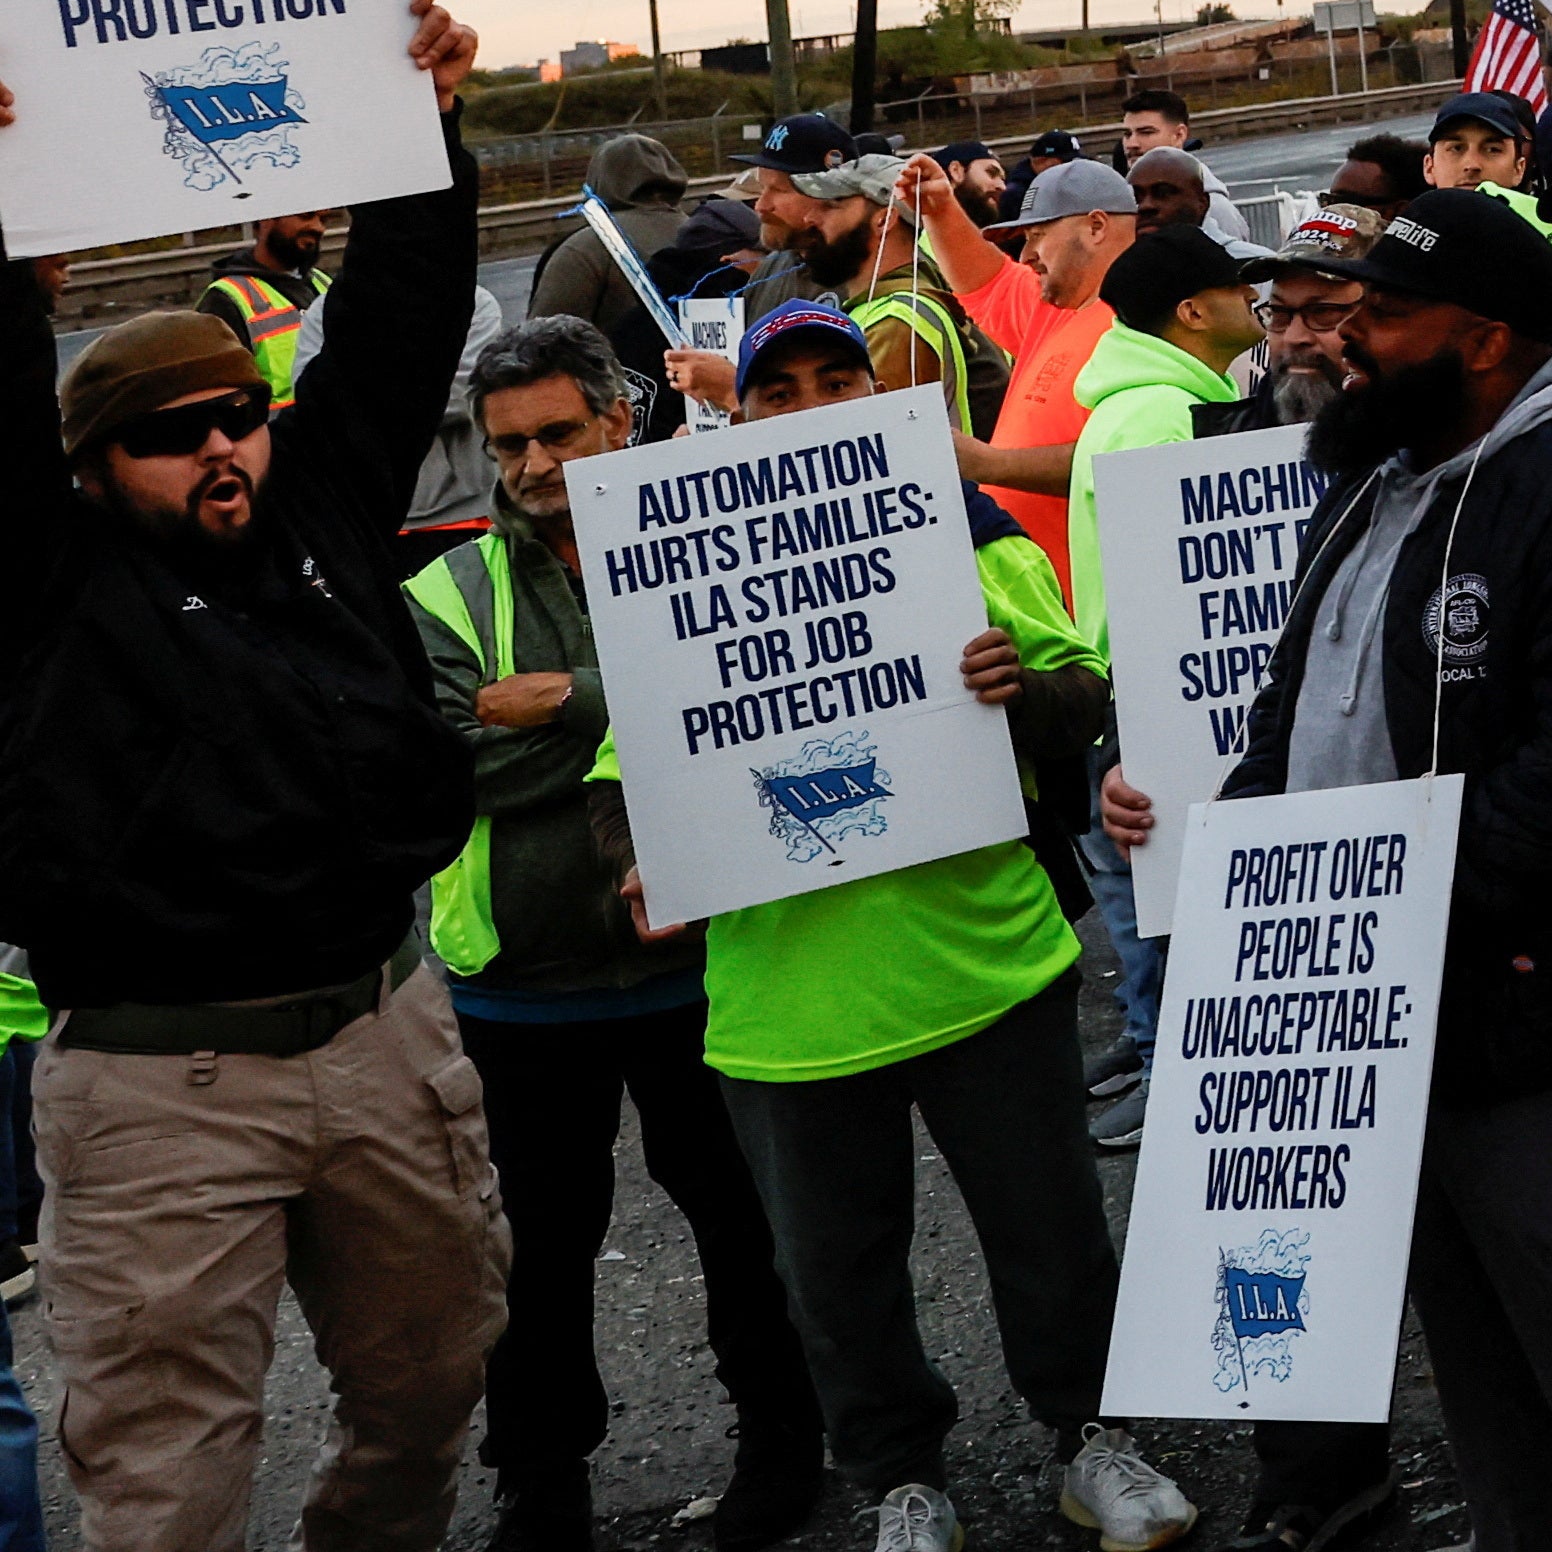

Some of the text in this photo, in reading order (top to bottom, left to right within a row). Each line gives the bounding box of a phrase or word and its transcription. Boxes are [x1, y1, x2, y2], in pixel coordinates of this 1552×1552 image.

[638, 434, 889, 532] AUTOMATION
[1180, 461, 1330, 525] MACHIN
[605, 482, 938, 597] HURTS FAMILIES:
[1178, 522, 1285, 584] DON'T
[670, 547, 896, 640] ILA STANDS
[715, 611, 872, 688] FOR JOB
[1179, 644, 1272, 701] SUPP
[682, 654, 927, 756] PROTECTION
[1225, 834, 1406, 909] PROFIT OVER
[1235, 911, 1378, 982] PEOPLE IS
[1182, 985, 1412, 1059] UNACCEPTABLE:
[1195, 1065, 1376, 1134] SUPPORT ILA
[1206, 1144, 1350, 1210] WORKERS
